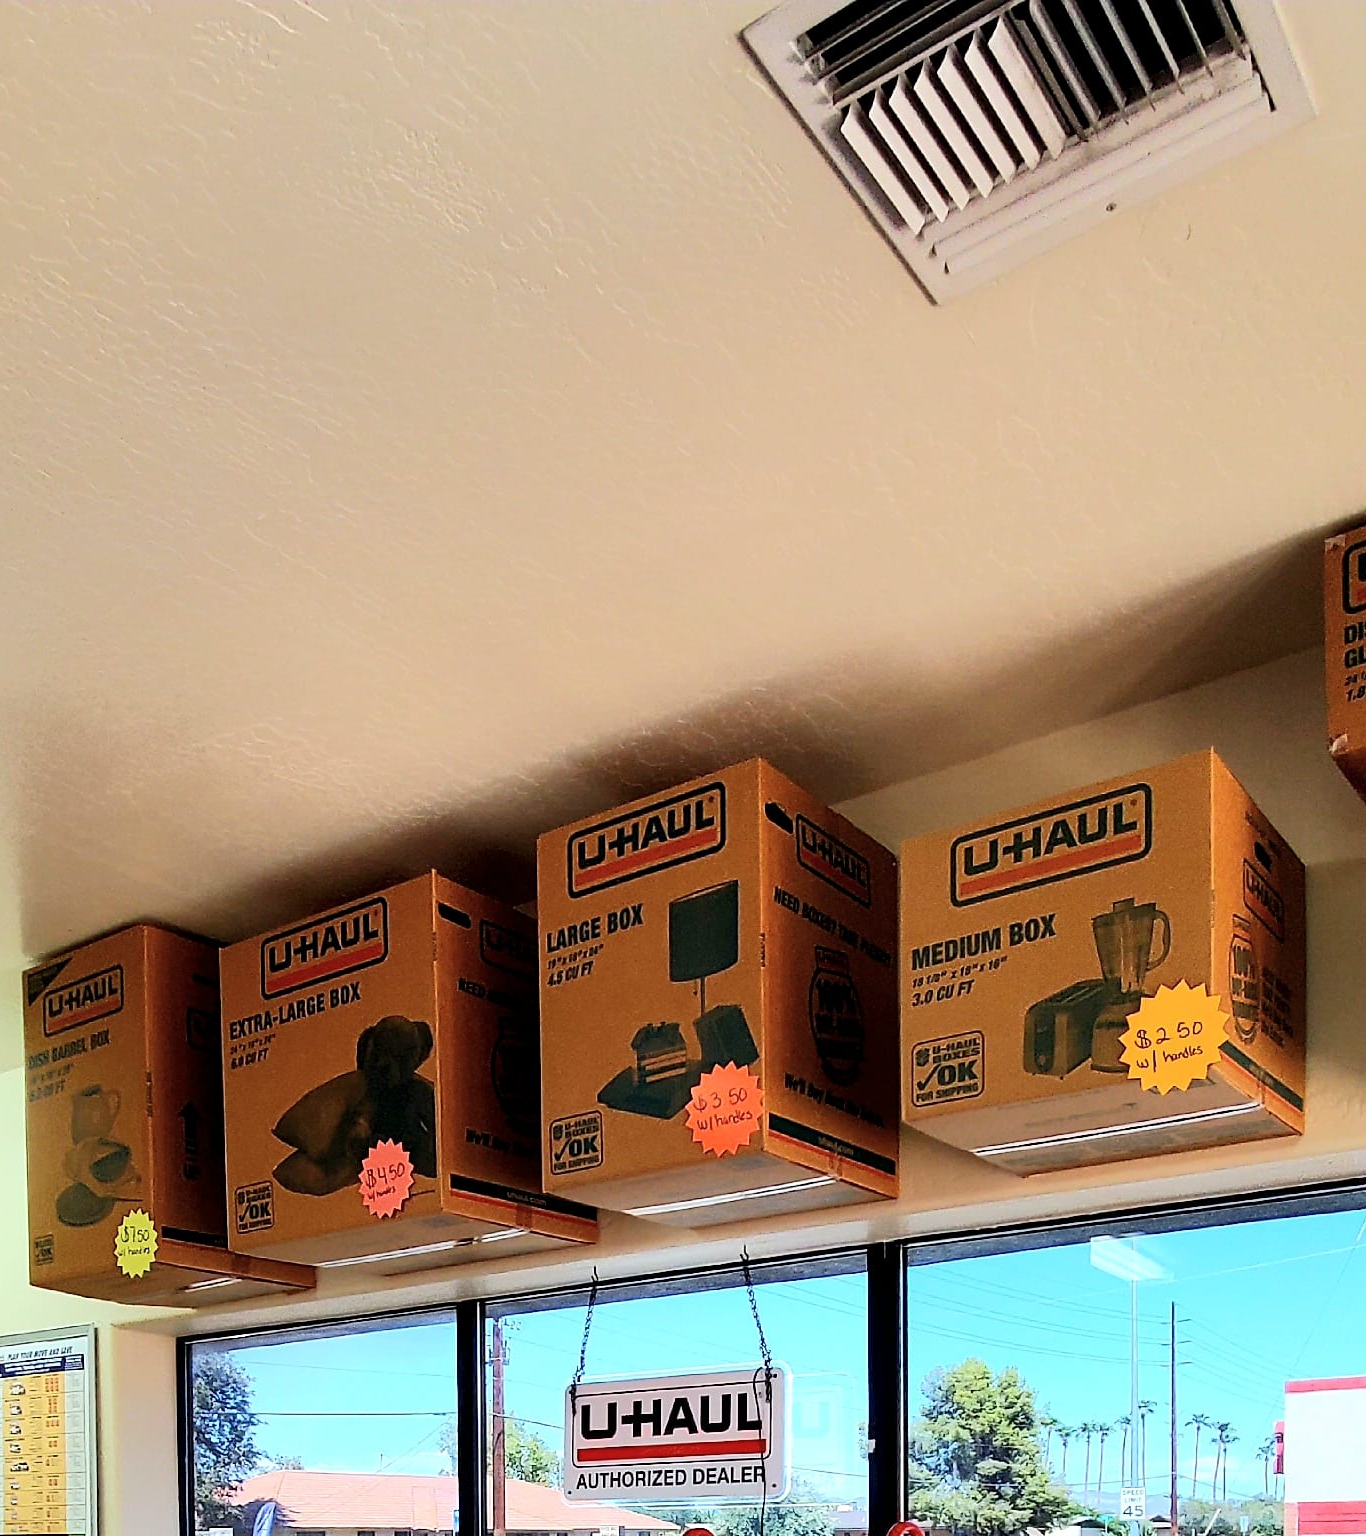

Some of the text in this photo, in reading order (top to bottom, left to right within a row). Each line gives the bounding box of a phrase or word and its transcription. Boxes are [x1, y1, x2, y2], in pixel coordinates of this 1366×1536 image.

[577, 798, 717, 871] U-HAUL
[963, 802, 1138, 877] U-HAUL
[774, 886, 800, 913] NEED
[546, 903, 645, 954] LARGE BOX
[268, 912, 379, 973] U-HAUL
[911, 926, 1002, 971] MEDIUM
[1009, 913, 1057, 947] BOX
[566, 965, 579, 981] CU
[581, 960, 594, 978] FT
[48, 975, 118, 1018] U-HAUL
[911, 979, 975, 1007] 3.0 CU FT
[229, 981, 362, 1041] EXTRA-LARGE BOX
[91, 1028, 111, 1050] BOX
[257, 1048, 269, 1062] FT
[932, 1046, 982, 1064] BOXES
[935, 1059, 979, 1085] OK
[916, 1081, 979, 1102] FOR SHIPPING
[567, 1134, 599, 1158] OK
[249, 1200, 271, 1219] OK
[581, 1393, 763, 1440] U-HAUL
[576, 1465, 766, 1490] AUTHORIZED DEALER
[1123, 1506, 1143, 1516] 45
